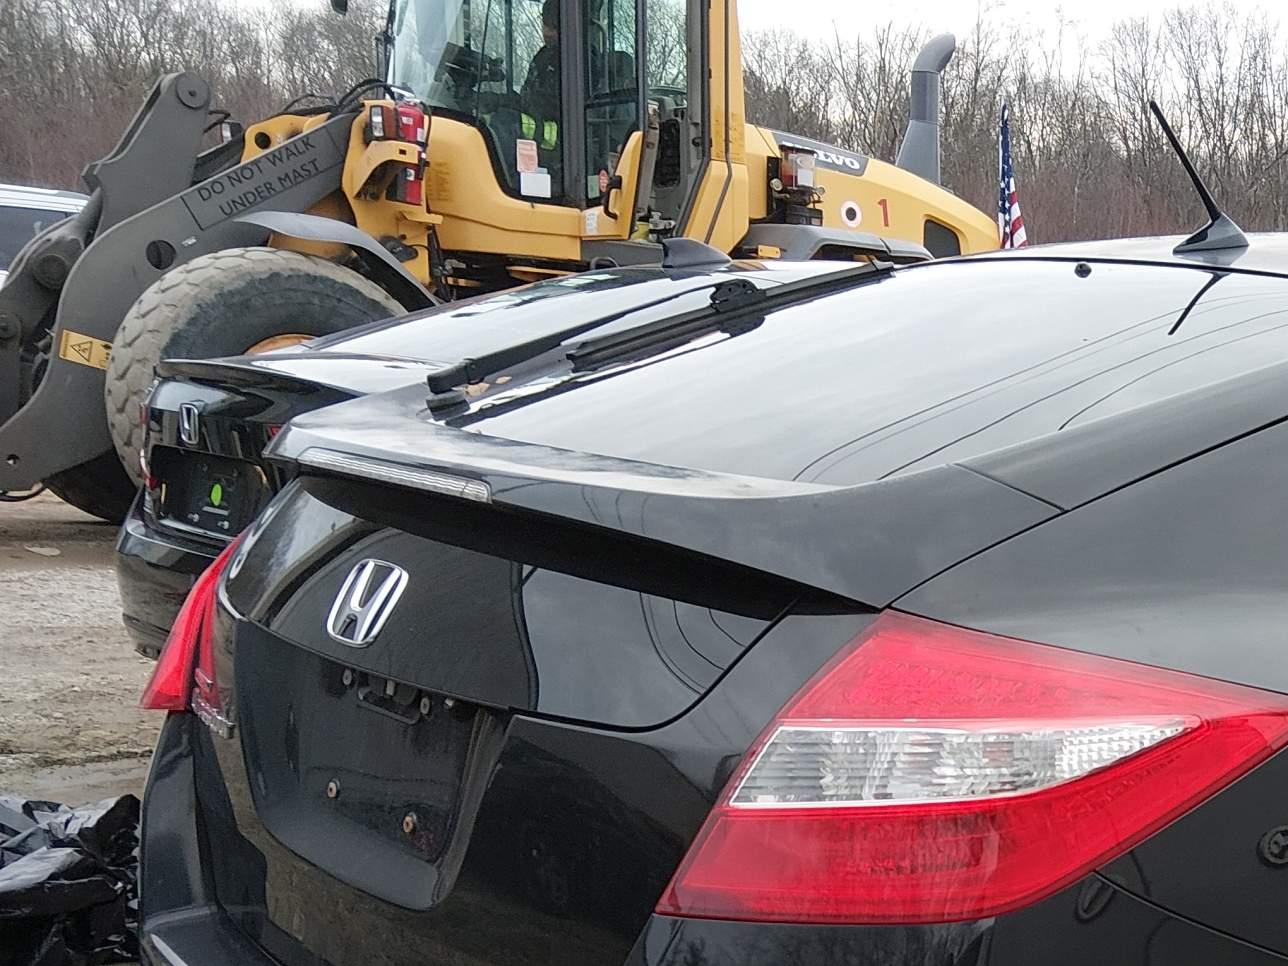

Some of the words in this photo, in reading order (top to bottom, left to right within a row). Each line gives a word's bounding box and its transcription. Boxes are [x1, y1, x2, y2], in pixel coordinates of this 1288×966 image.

[198, 180, 225, 202] DO
[227, 160, 263, 187] NOT
[266, 136, 315, 167] WALK
[219, 182, 276, 216] UNDER
[278, 158, 321, 188] MAST
[878, 199, 889, 228] 1
